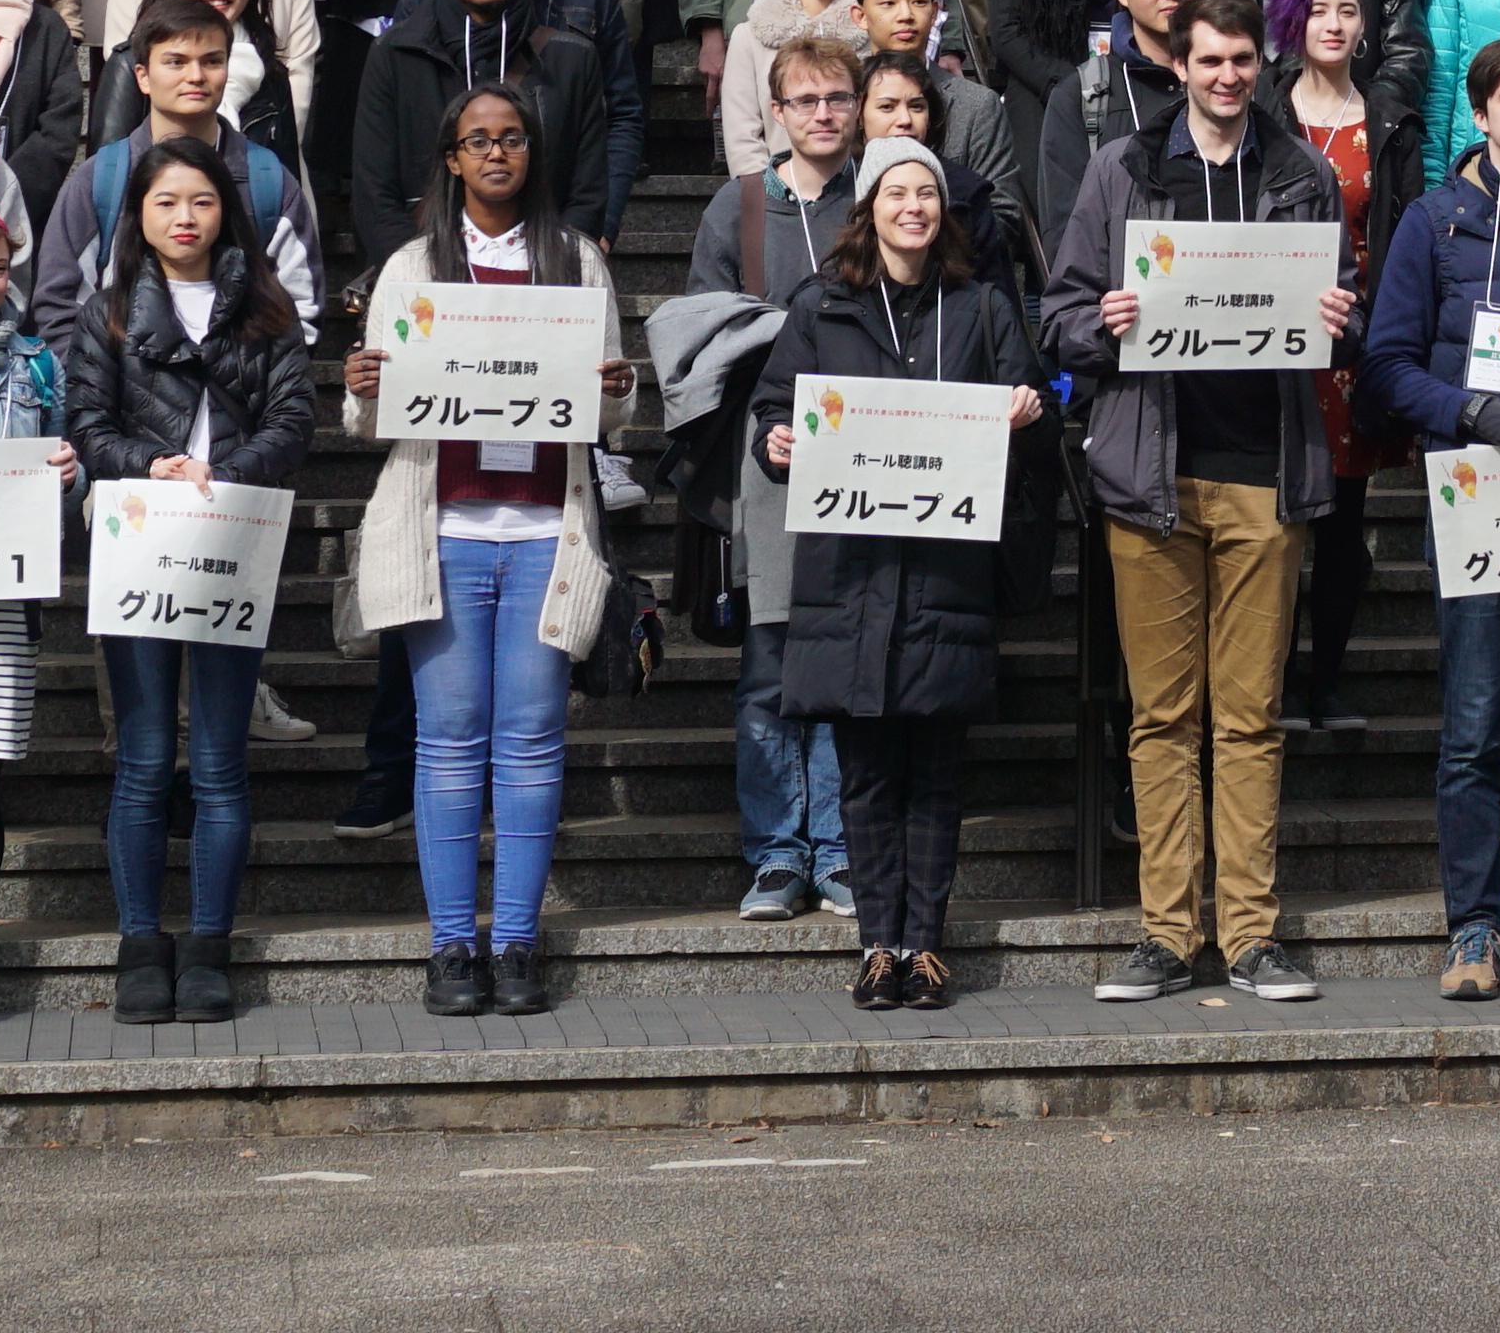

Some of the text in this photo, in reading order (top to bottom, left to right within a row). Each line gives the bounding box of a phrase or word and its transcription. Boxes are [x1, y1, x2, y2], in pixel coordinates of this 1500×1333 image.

[1185, 294, 1274, 308] ホール聴講時
[445, 359, 538, 376] ホール聴講時
[853, 453, 943, 471] ホール聴講時
[157, 555, 238, 576] ホール聴講時
